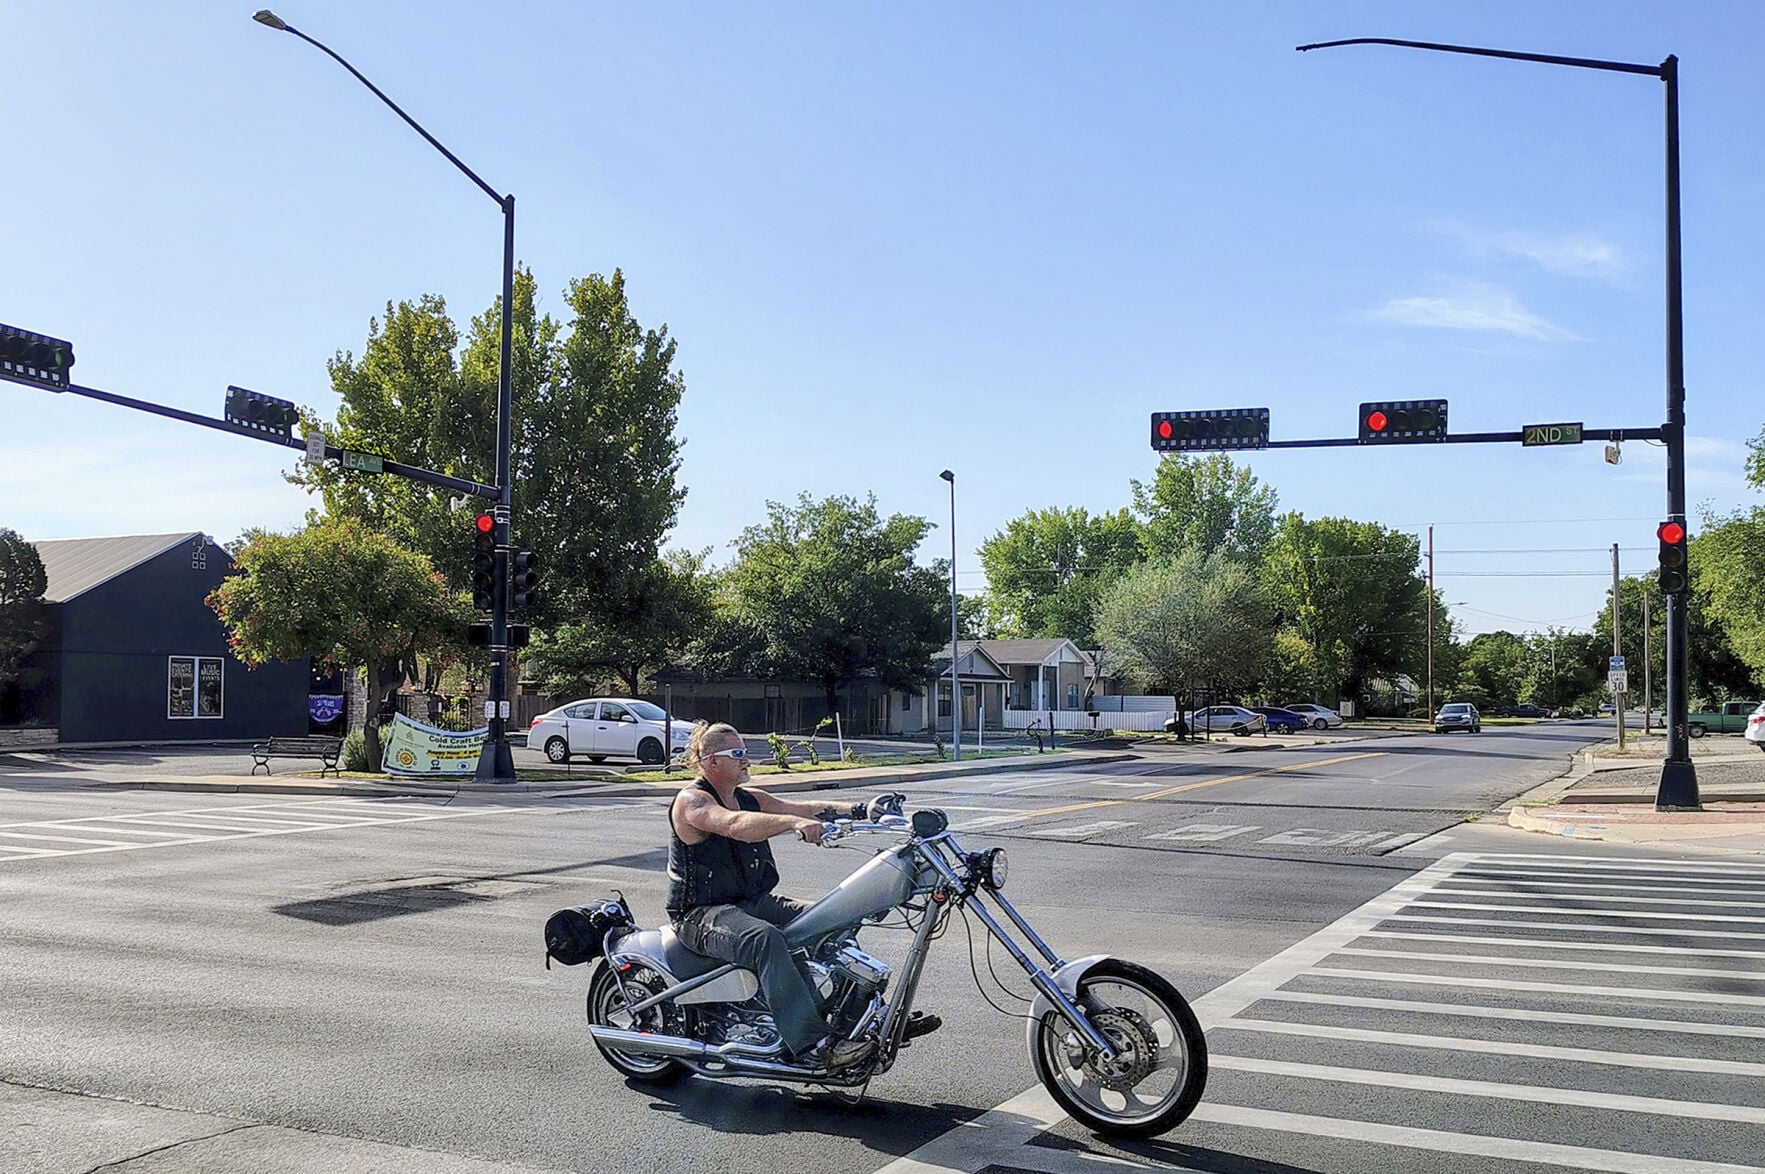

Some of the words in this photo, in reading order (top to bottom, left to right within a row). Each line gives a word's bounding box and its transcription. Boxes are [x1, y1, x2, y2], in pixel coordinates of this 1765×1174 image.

[1527, 427, 1562, 444] 2ND
[1612, 682, 1624, 691] 30
[428, 735, 448, 744] Cold
